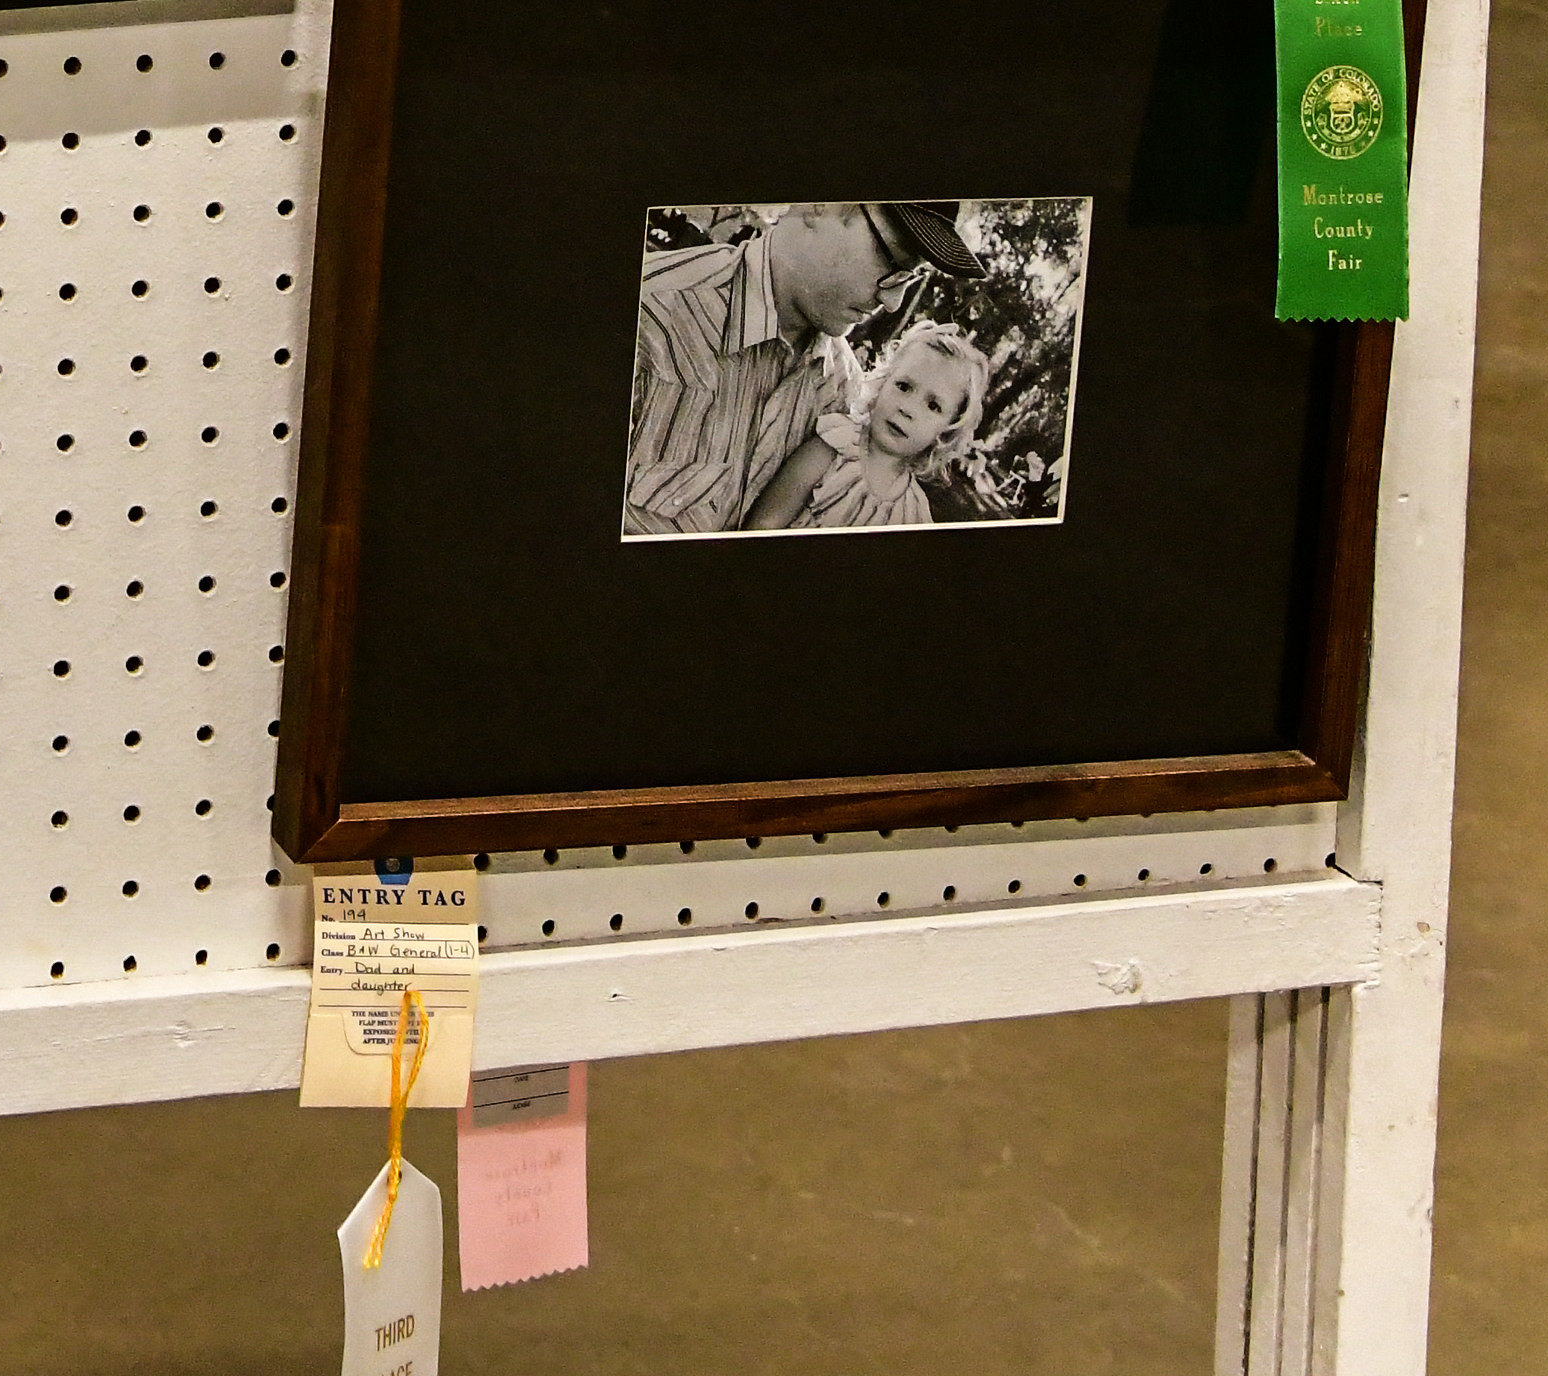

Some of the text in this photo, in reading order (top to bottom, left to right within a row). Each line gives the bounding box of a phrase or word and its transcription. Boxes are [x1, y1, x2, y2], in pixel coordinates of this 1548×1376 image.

[1315, 16, 1364, 37] Place
[1338, 68, 1381, 112] COLORADO
[1303, 184, 1384, 206] Montrose
[1314, 216, 1373, 240] County
[1328, 249, 1363, 271] Fair
[322, 887, 466, 906] ENTRY TAG
[321, 908, 367, 922] No. 194
[321, 927, 425, 940] Division Art Show
[321, 949, 344, 957] Class
[390, 945, 442, 959] General
[320, 961, 416, 976] Entry Dad and
[374, 1314, 415, 1352] THIRD
